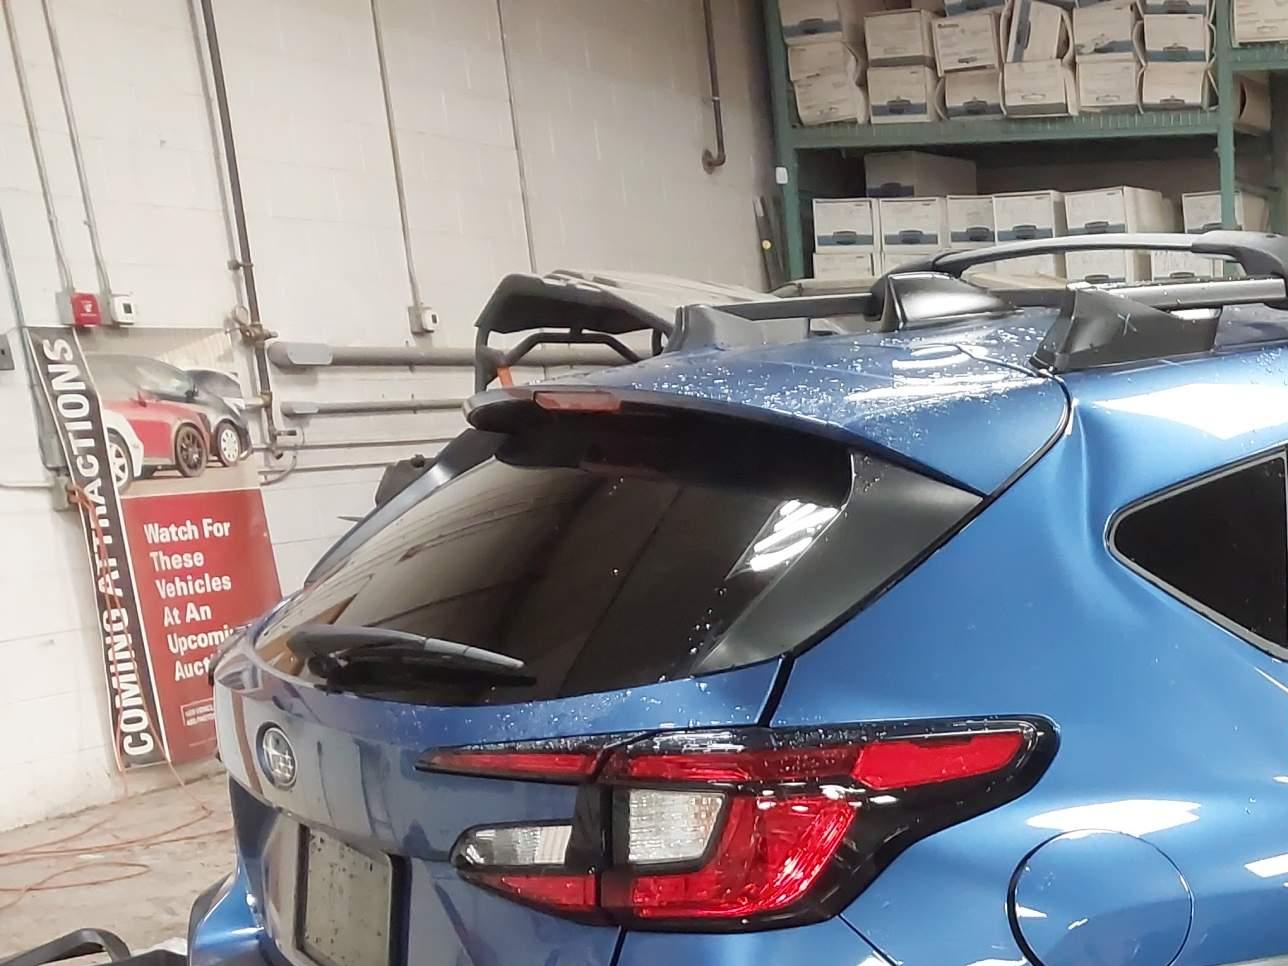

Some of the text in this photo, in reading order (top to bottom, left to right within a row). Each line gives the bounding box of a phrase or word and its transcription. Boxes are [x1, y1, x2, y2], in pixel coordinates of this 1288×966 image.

[144, 518, 231, 544] Watch For
[150, 551, 204, 572] These
[155, 573, 232, 599] Vehicles
[163, 602, 212, 627] At An
[167, 624, 233, 656] Upcomi
[175, 654, 213, 682] Auct
[103, 607, 154, 756] COMING
